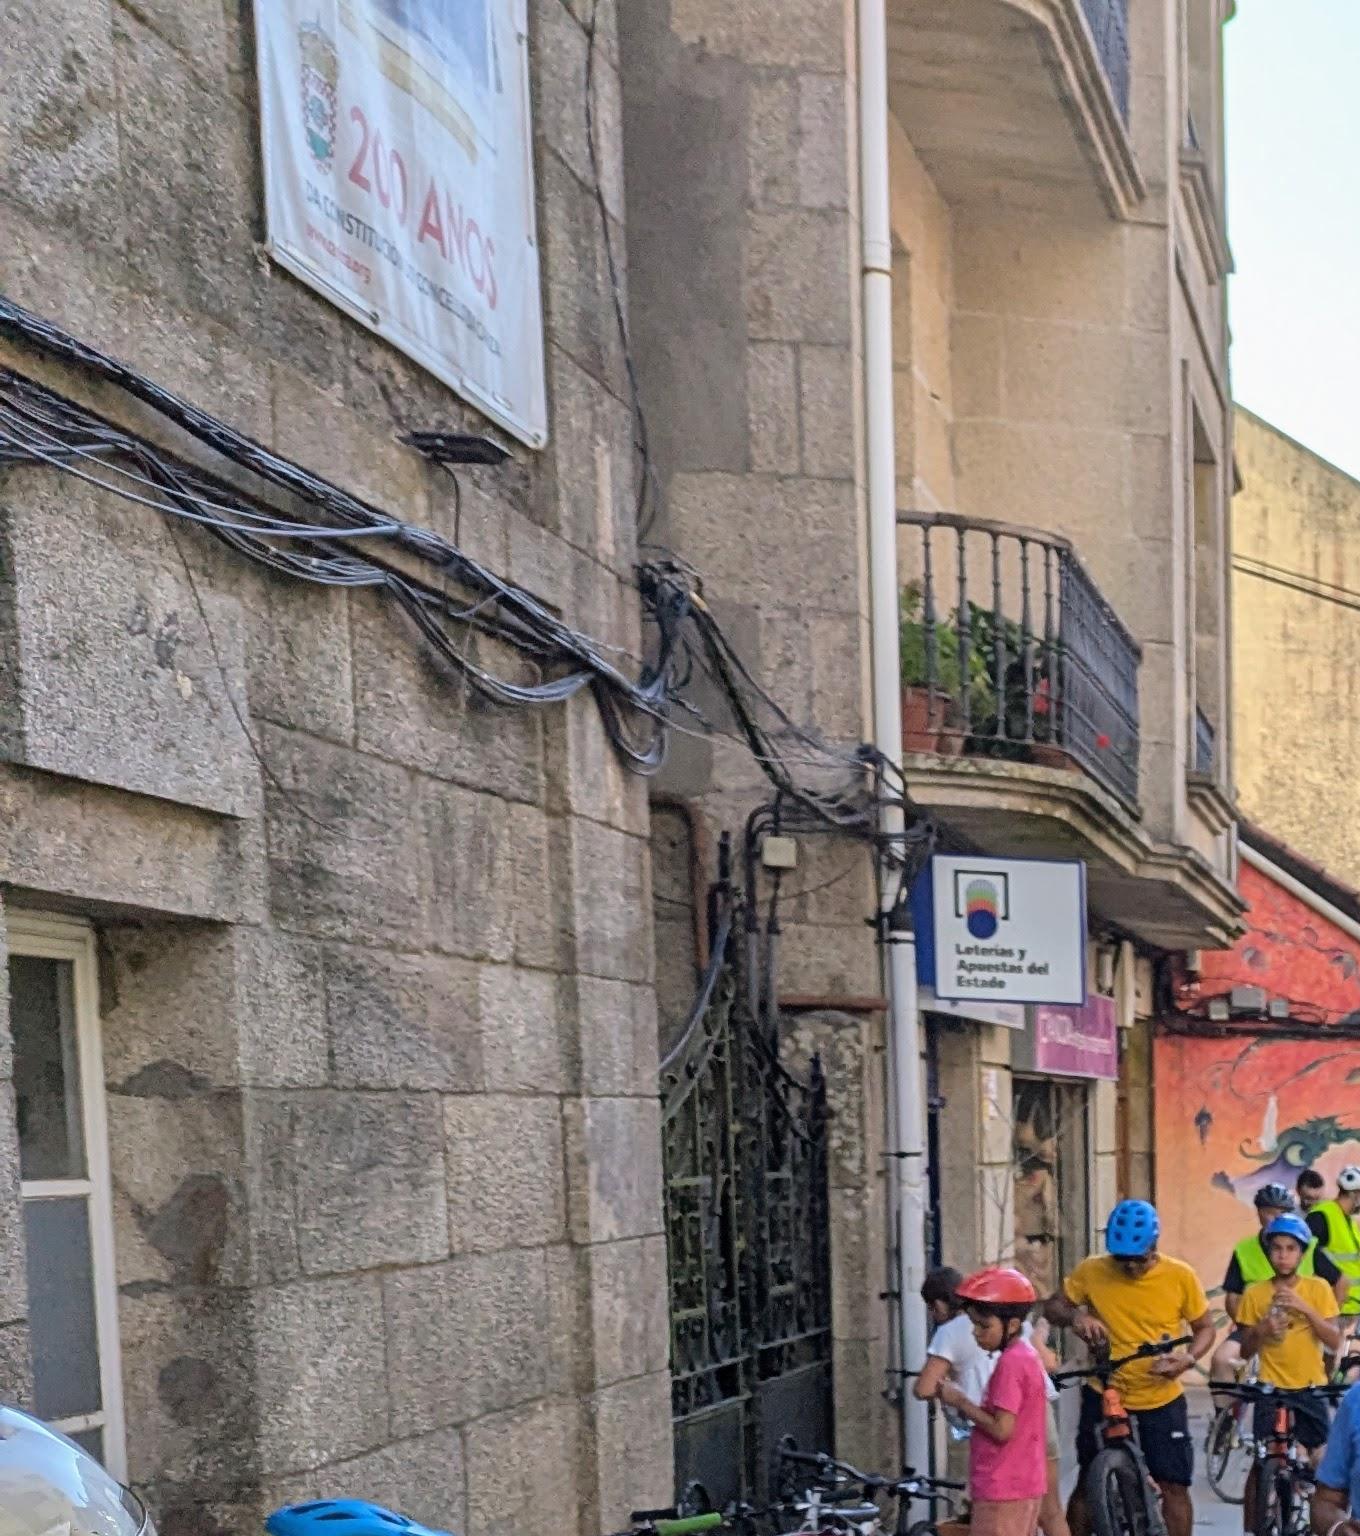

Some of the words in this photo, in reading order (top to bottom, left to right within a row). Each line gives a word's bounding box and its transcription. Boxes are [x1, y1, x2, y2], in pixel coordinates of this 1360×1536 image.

[348, 105, 409, 228] 200
[417, 176, 498, 311] ANOS
[1017, 948, 1027, 961] y
[956, 959, 1024, 975] Apuestas
[1027, 962, 1049, 976] del
[956, 975, 1006, 990] Estado
